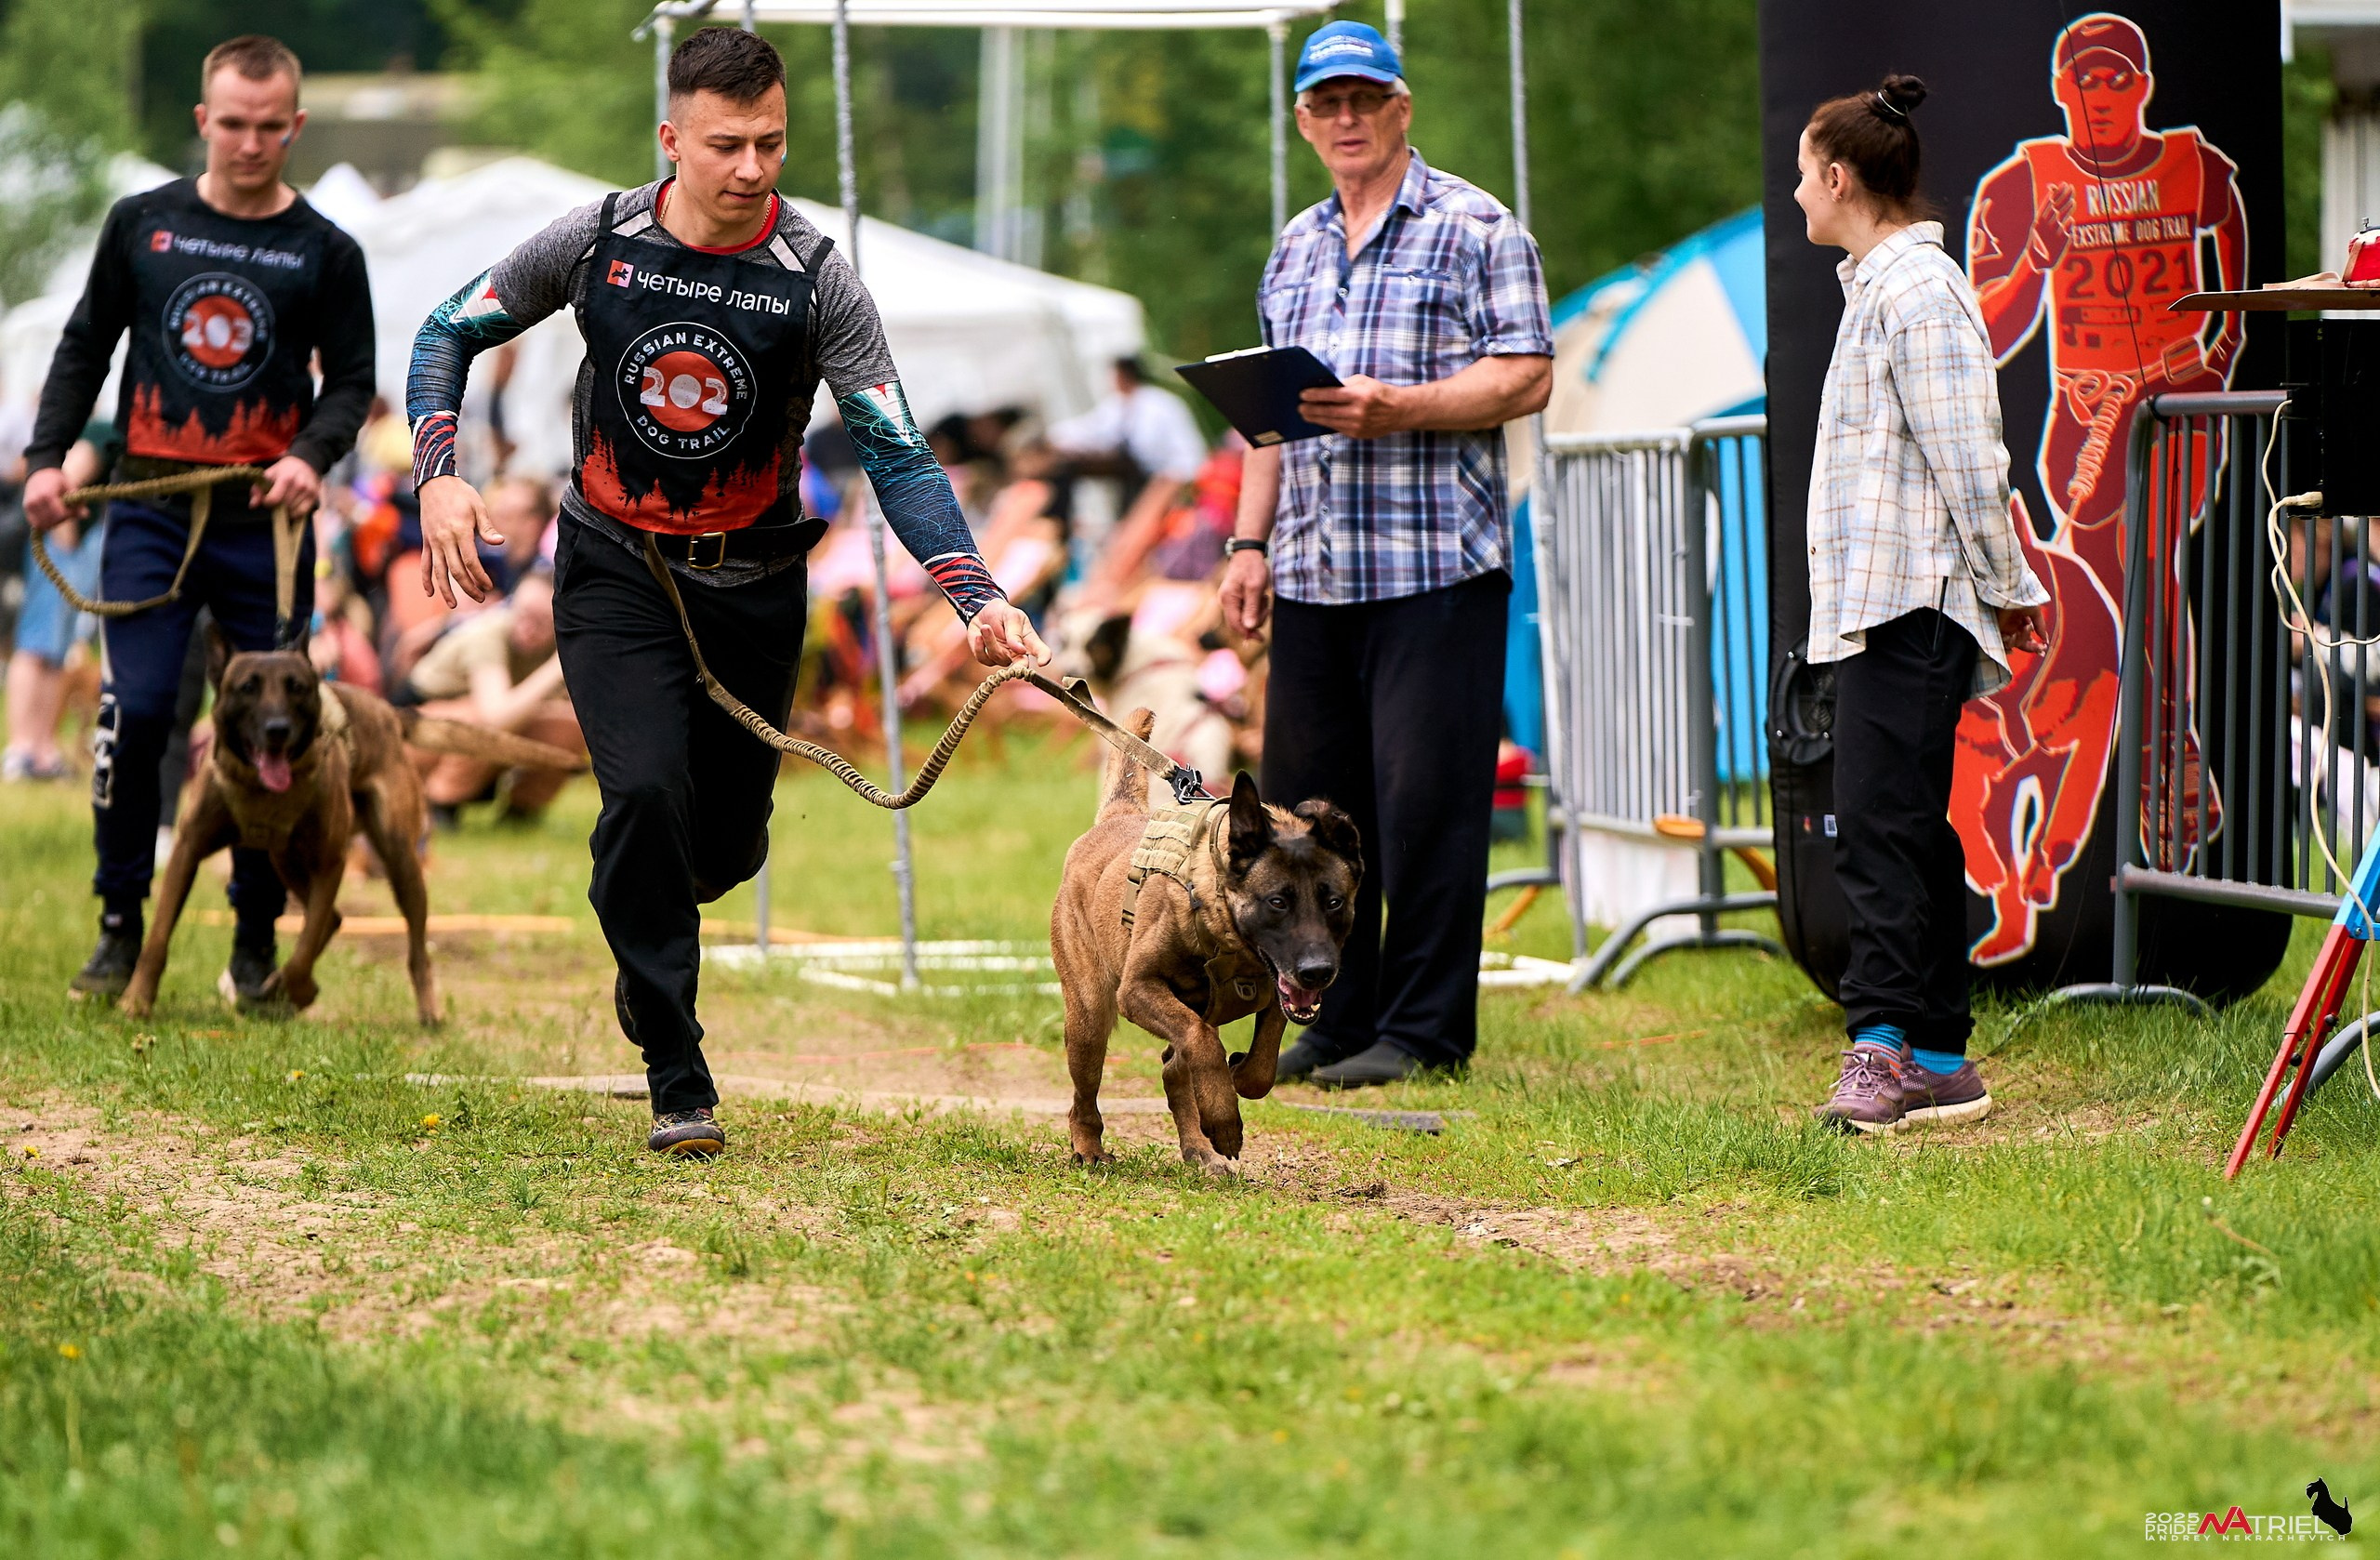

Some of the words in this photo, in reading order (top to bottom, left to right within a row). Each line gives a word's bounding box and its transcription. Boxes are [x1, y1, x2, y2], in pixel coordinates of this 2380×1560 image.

[2085, 179, 2162, 216] RUSSIAN
[2135, 218, 2161, 243] DOG
[2061, 247, 2195, 299] 2021
[624, 331, 687, 385] RUSSIAN
[693, 333, 747, 400] EXTREME
[637, 415, 670, 445] DOG
[678, 425, 731, 450] TRAIL
